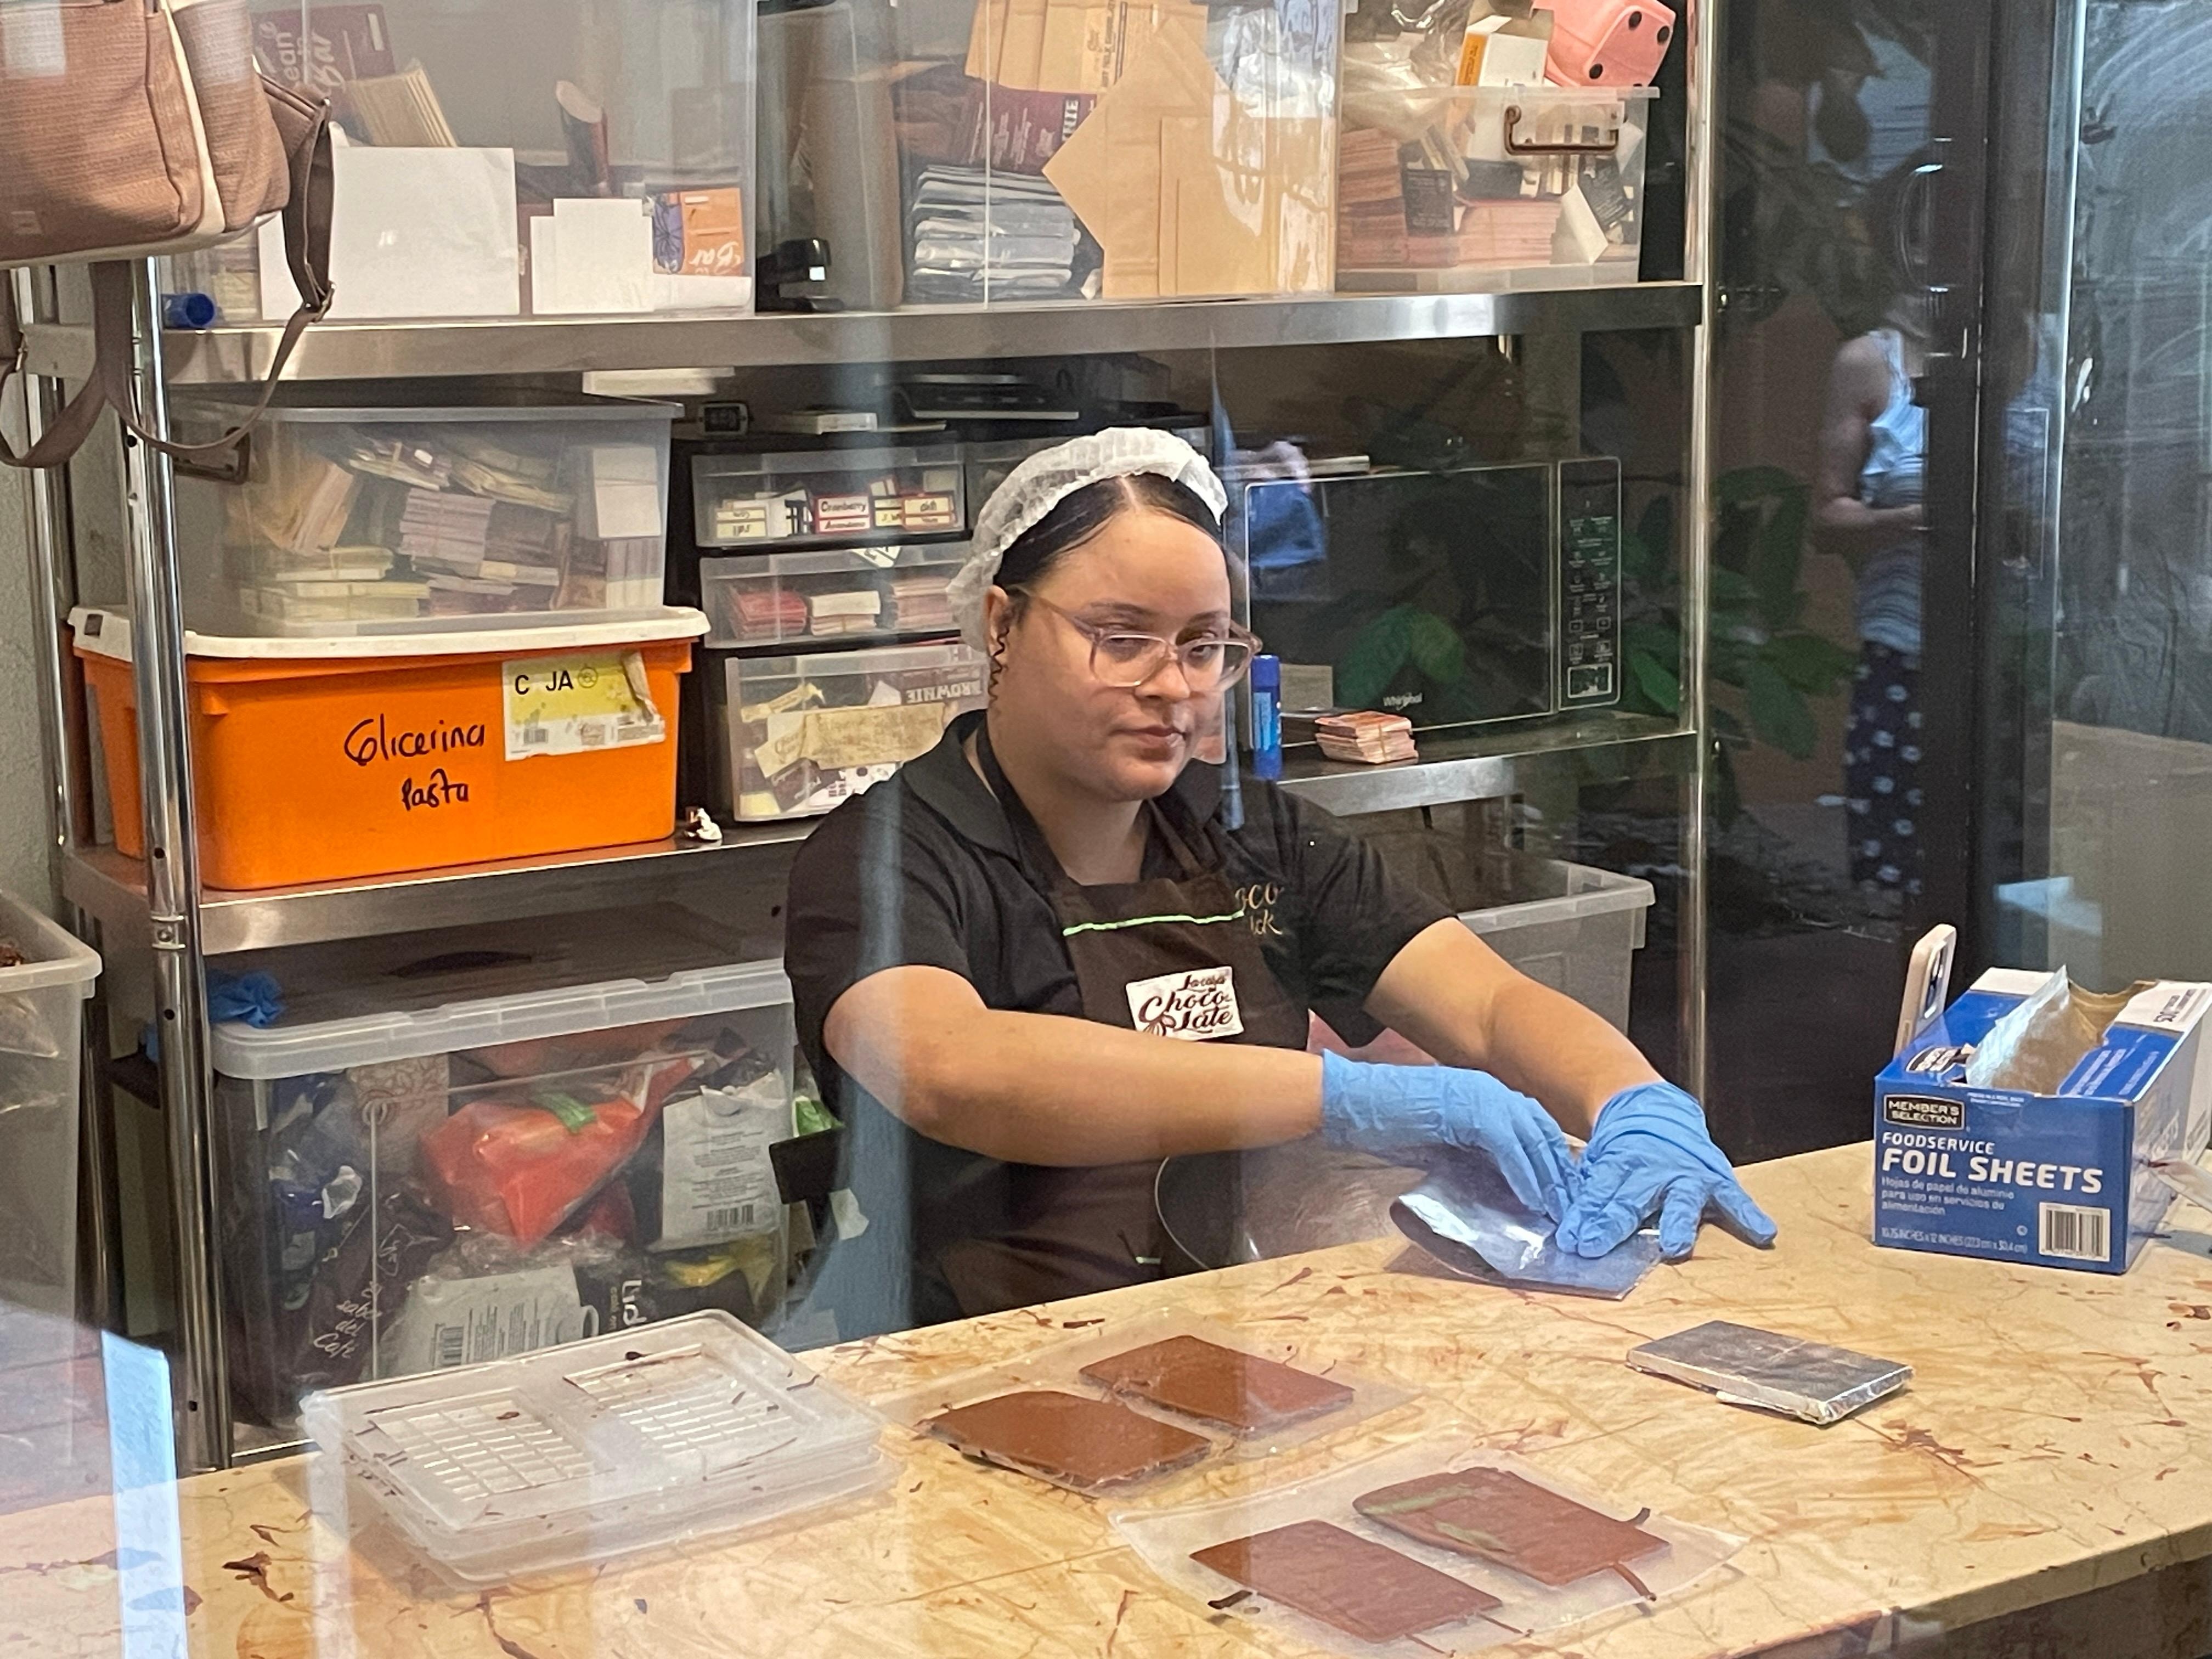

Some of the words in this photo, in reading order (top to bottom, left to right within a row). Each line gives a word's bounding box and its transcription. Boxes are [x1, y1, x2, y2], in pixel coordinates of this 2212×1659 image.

[1889, 1101, 1960, 1116] MEMBER'S
[1891, 1110, 1957, 1125] SELECTION
[1882, 1132, 1995, 1155] FOODSERVICE
[1882, 1148, 1956, 1178] FOIL
[1968, 1156, 2103, 1194] SHEETS
[1882, 1176, 1910, 1189] Hojas
[1911, 1179, 1925, 1190] de
[1927, 1182, 1954, 1194] papel
[1956, 1184, 1968, 1195] de
[1971, 1187, 2015, 1200] aluminio
[1882, 1189, 1906, 1201] para
[1928, 1194, 1942, 1204] en
[1992, 1200, 2005, 1210] de
